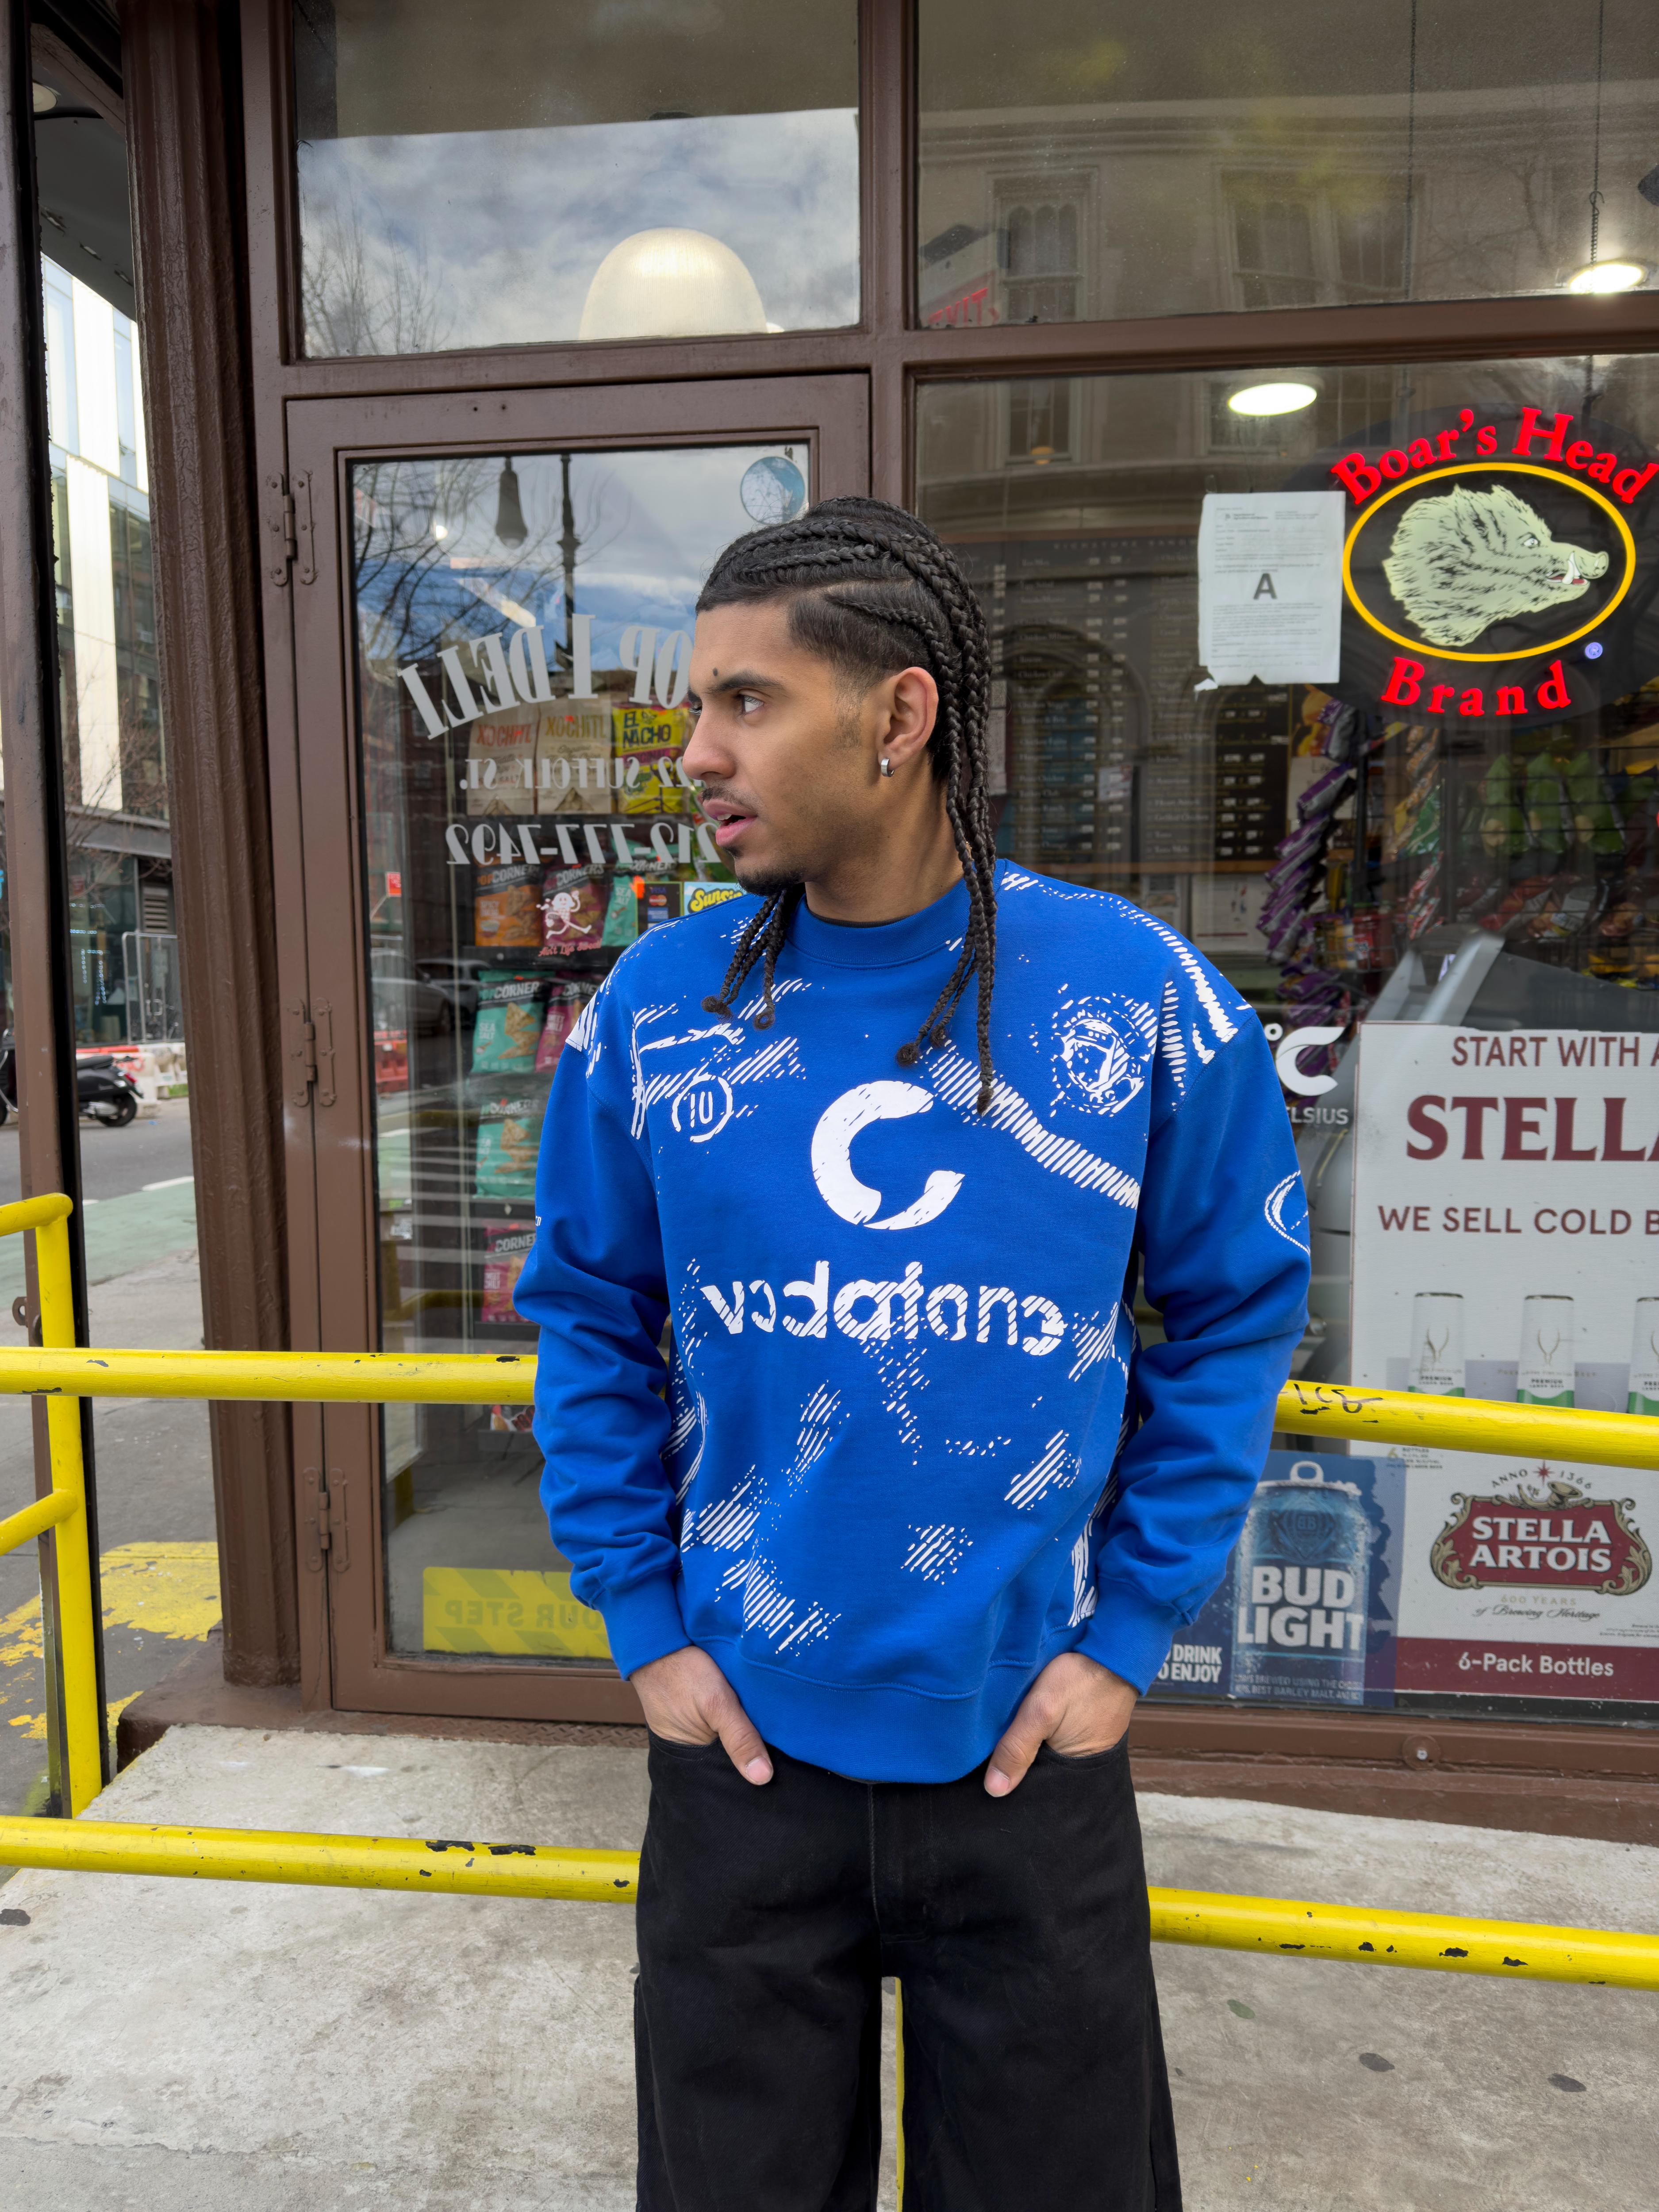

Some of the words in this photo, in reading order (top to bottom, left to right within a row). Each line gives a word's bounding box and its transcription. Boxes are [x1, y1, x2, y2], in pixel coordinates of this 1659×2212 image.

[1331, 409, 1497, 505] Boar's
[1512, 407, 1659, 504] Head
[1253, 572, 1278, 600] A
[1381, 657, 1571, 717] Brand
[623, 724, 671, 749] NACHO
[1451, 1036, 1548, 1067] START
[1557, 1036, 1640, 1067] WITH
[1286, 1106, 1349, 1125] LSIUS
[1378, 1205, 1431, 1232] WE
[1442, 1207, 1522, 1233] SELL
[1534, 1209, 1632, 1235] COLD
[1491, 1468, 1528, 1488] ANNO
[1560, 1470, 1592, 1490] 1366
[1472, 1516, 1612, 1544] STELLA
[1469, 1544, 1612, 1573] ARTOIS
[1252, 1566, 1355, 1609] BUD
[1533, 1596, 1577, 1607] YEARS
[1237, 1606, 1364, 1651] LIGHT
[1171, 1644, 1222, 1665] DRINK
[1459, 1651, 1533, 1674] 6-Pack
[1539, 1655, 1614, 1677] Bottles
[1171, 1663, 1222, 1684] ENJOY
